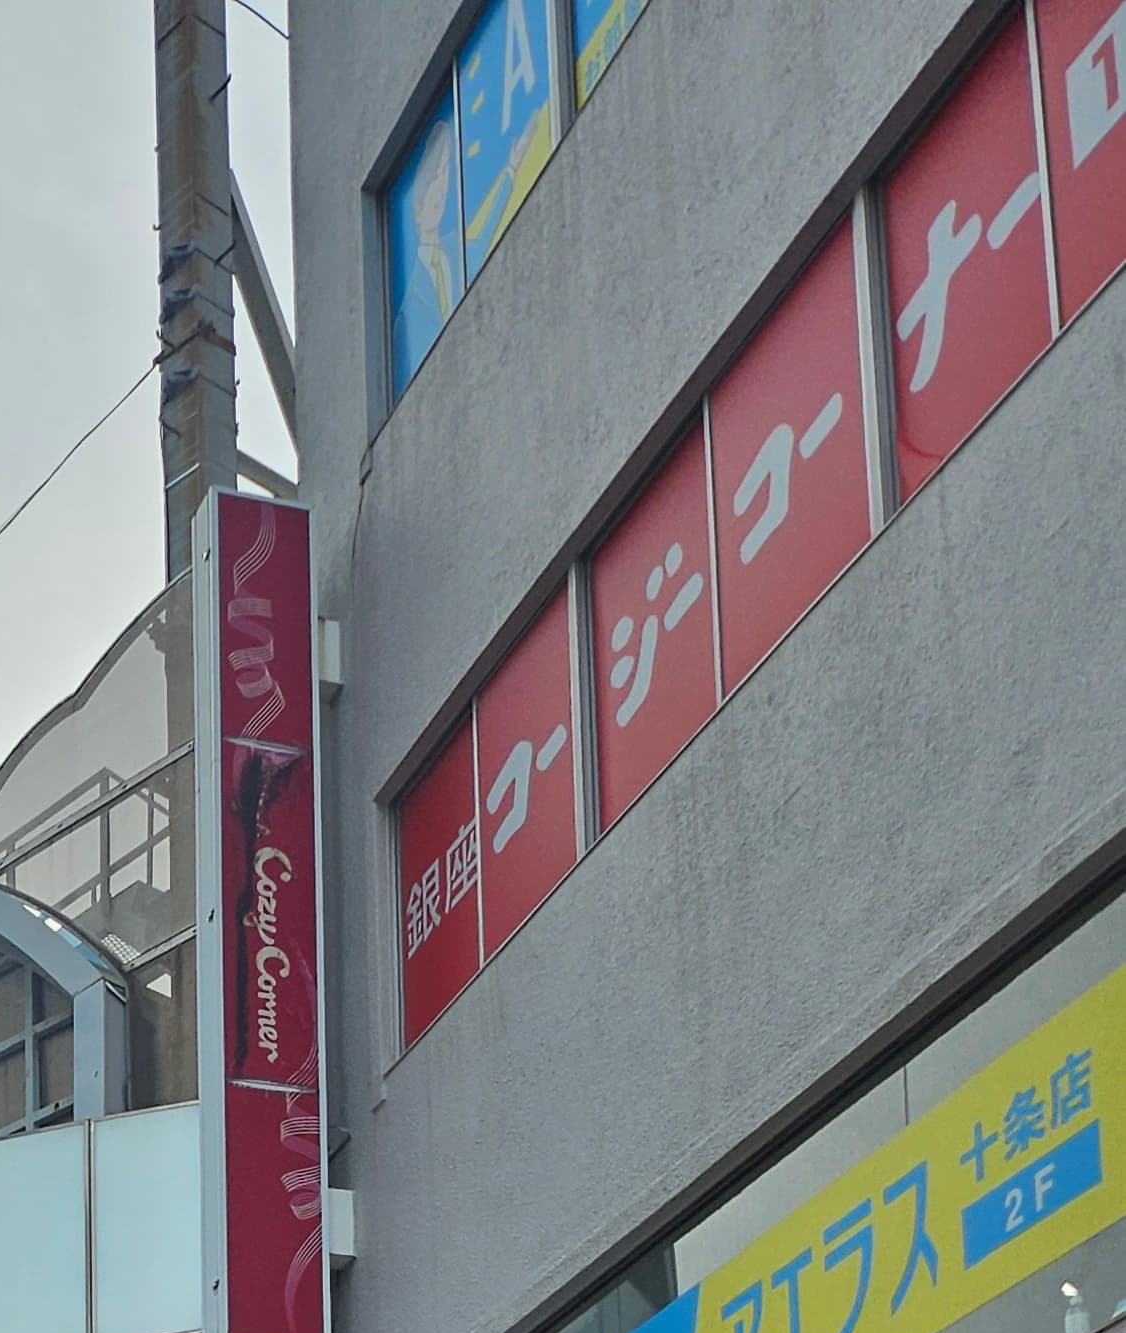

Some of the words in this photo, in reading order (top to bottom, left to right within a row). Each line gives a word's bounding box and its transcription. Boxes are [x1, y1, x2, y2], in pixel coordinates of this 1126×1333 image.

[243, 847, 292, 946] Cozy
[256, 946, 290, 1064] Corner
[960, 1048, 1093, 1181] 十条店
[1004, 1162, 1055, 1231] 2F
